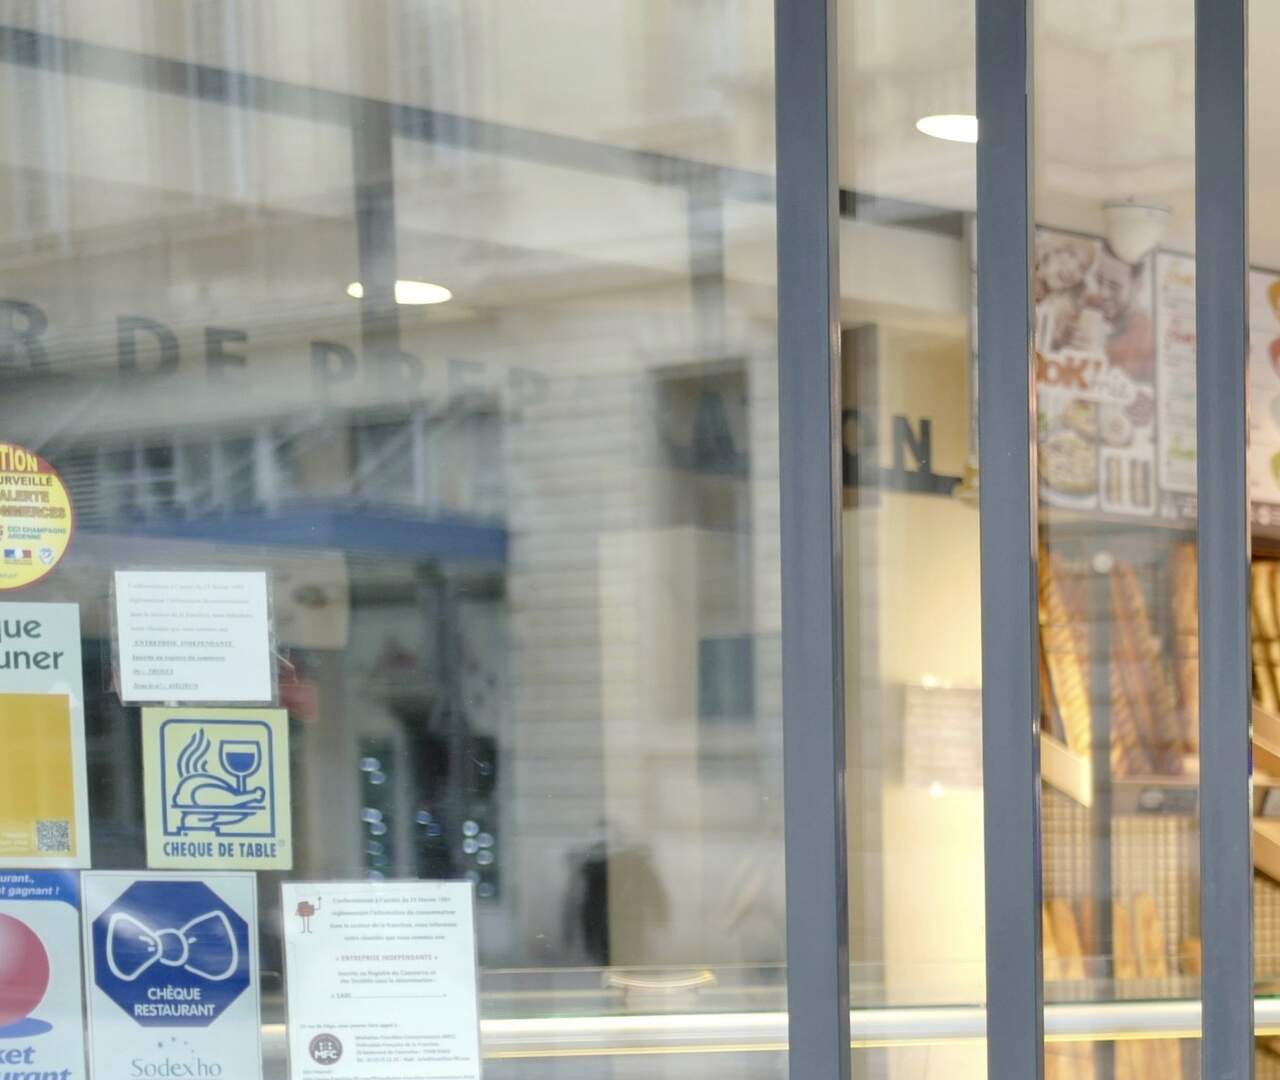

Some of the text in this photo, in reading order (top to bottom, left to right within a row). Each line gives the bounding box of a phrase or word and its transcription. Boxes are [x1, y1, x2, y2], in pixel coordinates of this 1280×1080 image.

[163, 842, 277, 858] CHEQUE DE TABLE
[147, 984, 202, 1000] CHÈQUE
[134, 1004, 216, 1017] RESTAURANT
